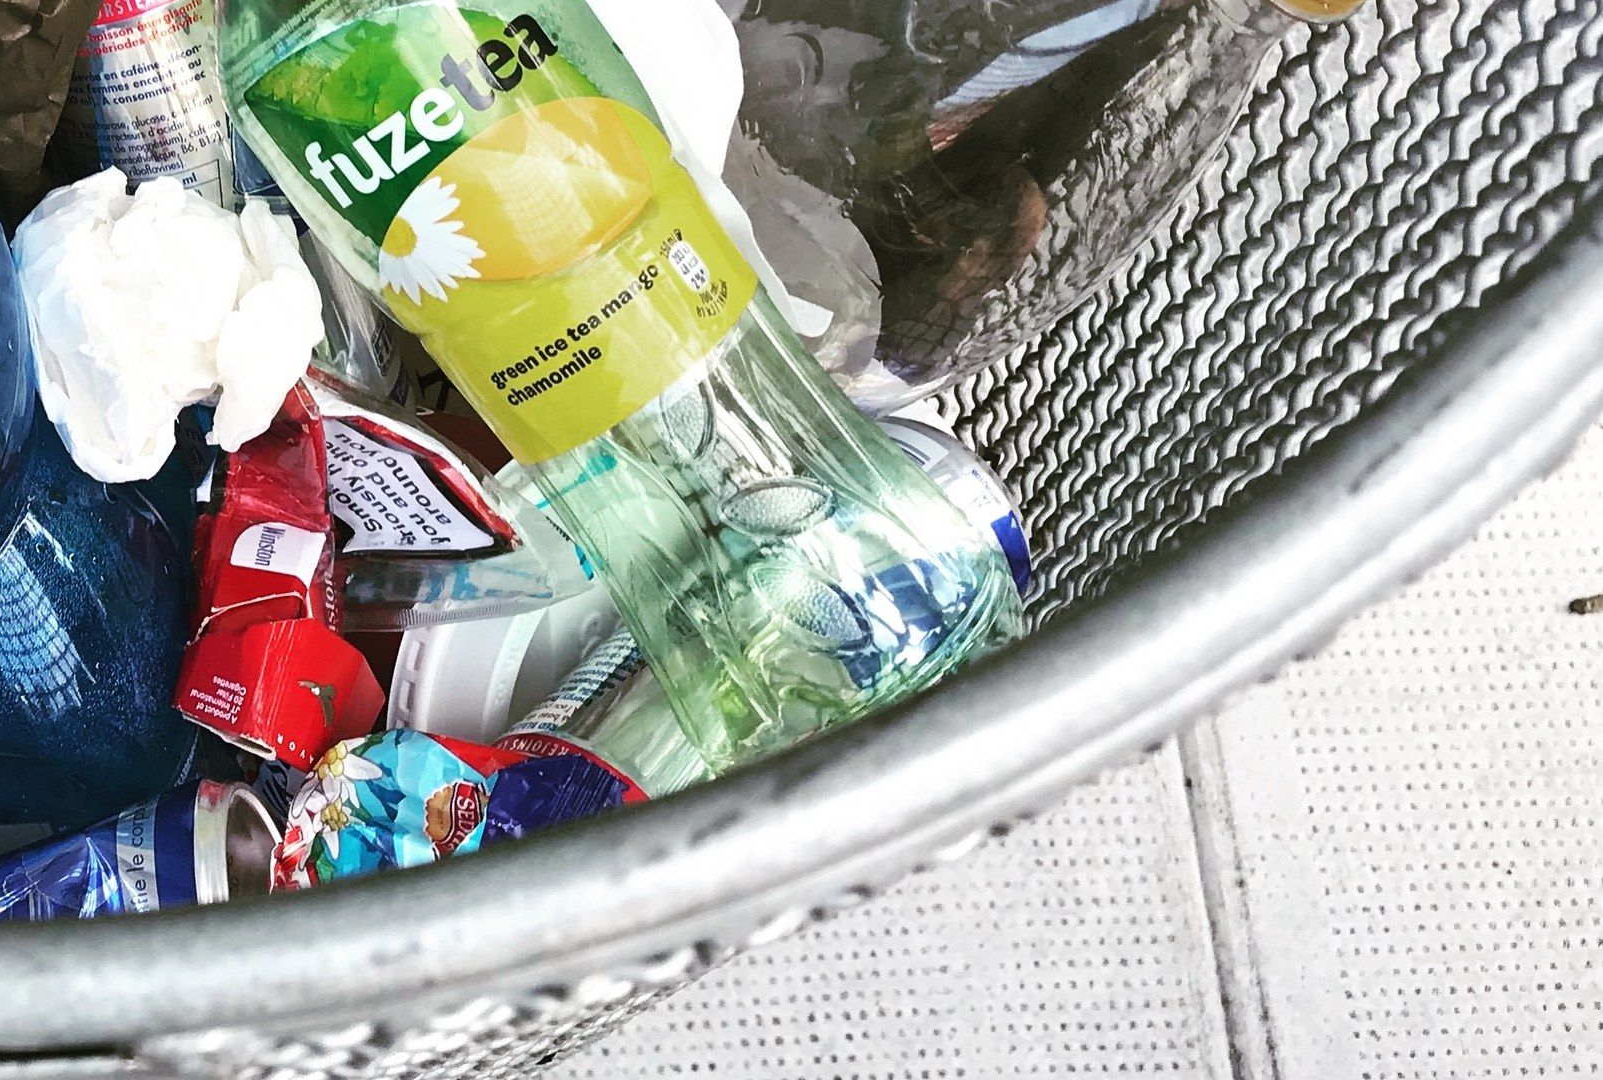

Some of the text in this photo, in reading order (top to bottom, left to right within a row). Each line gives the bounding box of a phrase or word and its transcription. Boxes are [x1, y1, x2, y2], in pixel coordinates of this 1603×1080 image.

[490, 263, 659, 389] green ice tea mango
[504, 342, 603, 406] chamomile
[333, 432, 452, 524] around you
[366, 470, 409, 509] and
[254, 526, 285, 566] Winston
[131, 807, 150, 846] corp
